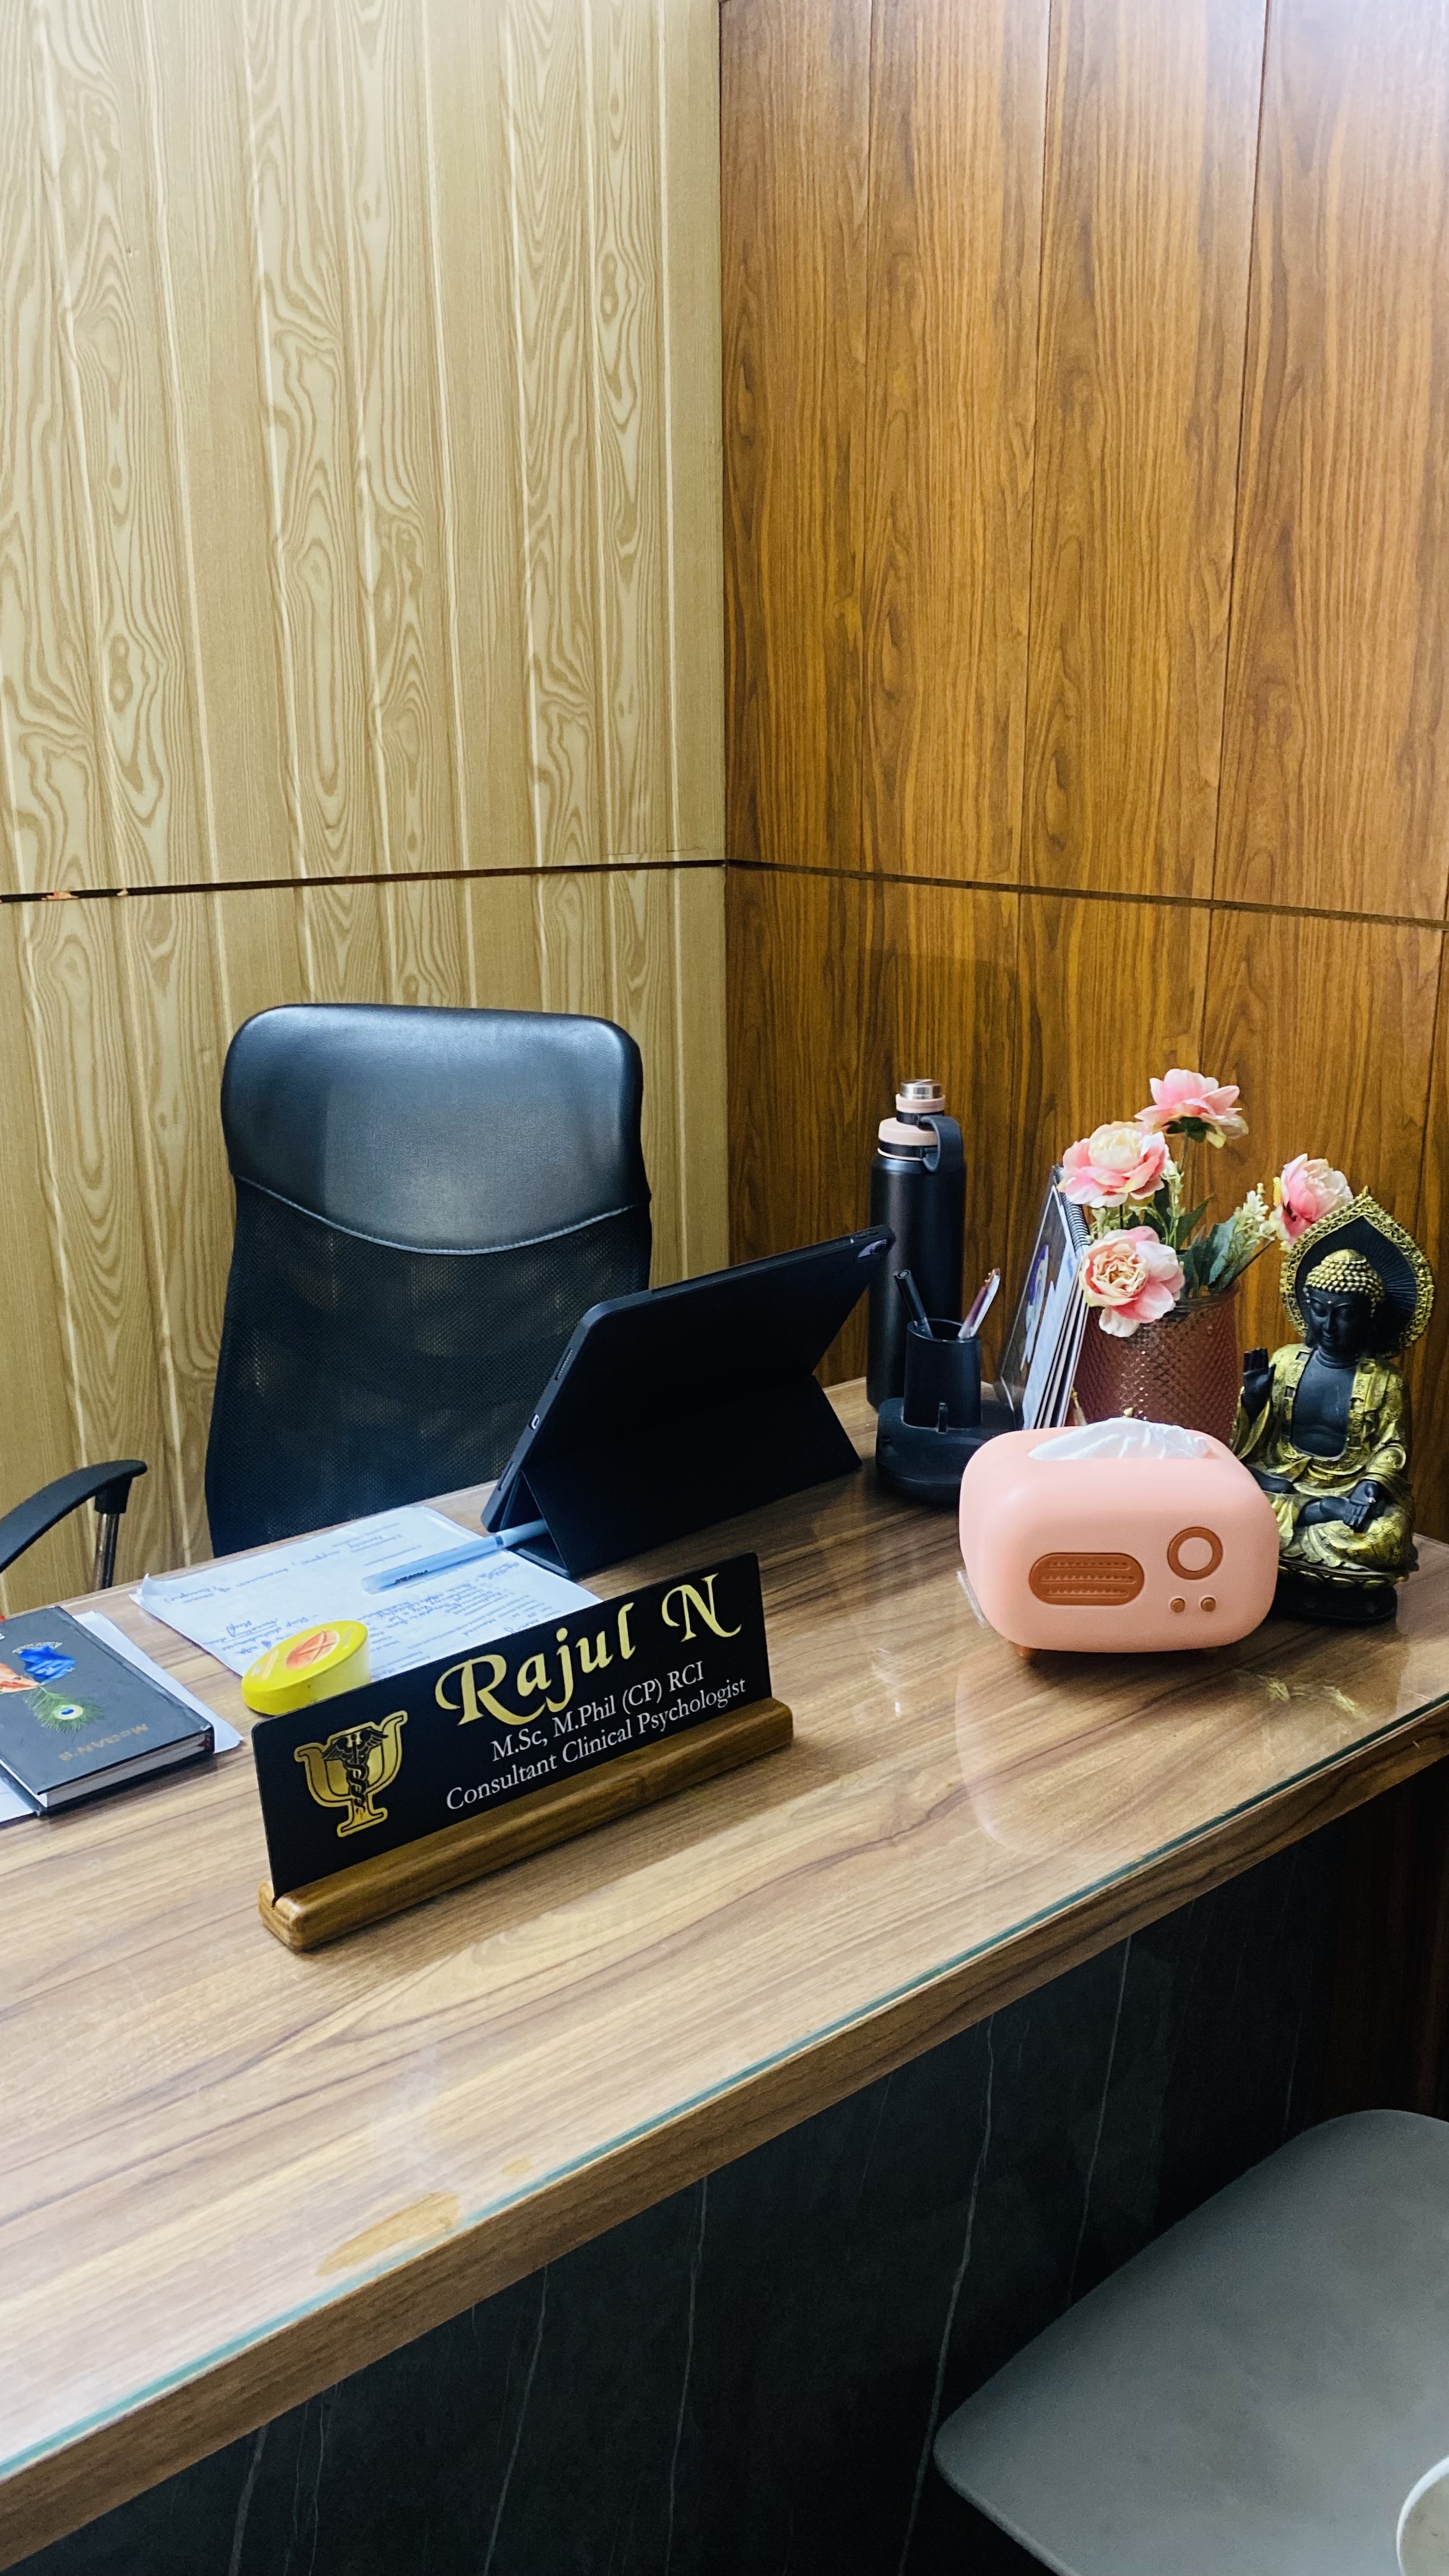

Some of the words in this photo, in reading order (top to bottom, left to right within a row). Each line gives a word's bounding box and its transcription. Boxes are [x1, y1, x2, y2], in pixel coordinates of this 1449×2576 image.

[434, 1602, 636, 1726] Rajul
[661, 1572, 742, 1643] N
[551, 1695, 617, 1737] M.Phil
[622, 1678, 663, 1714] (CP)
[668, 1661, 705, 1692] RCI
[447, 1753, 557, 1810] Consultant
[562, 1720, 632, 1763] Clinical
[636, 1677, 747, 1736] Psychologist
